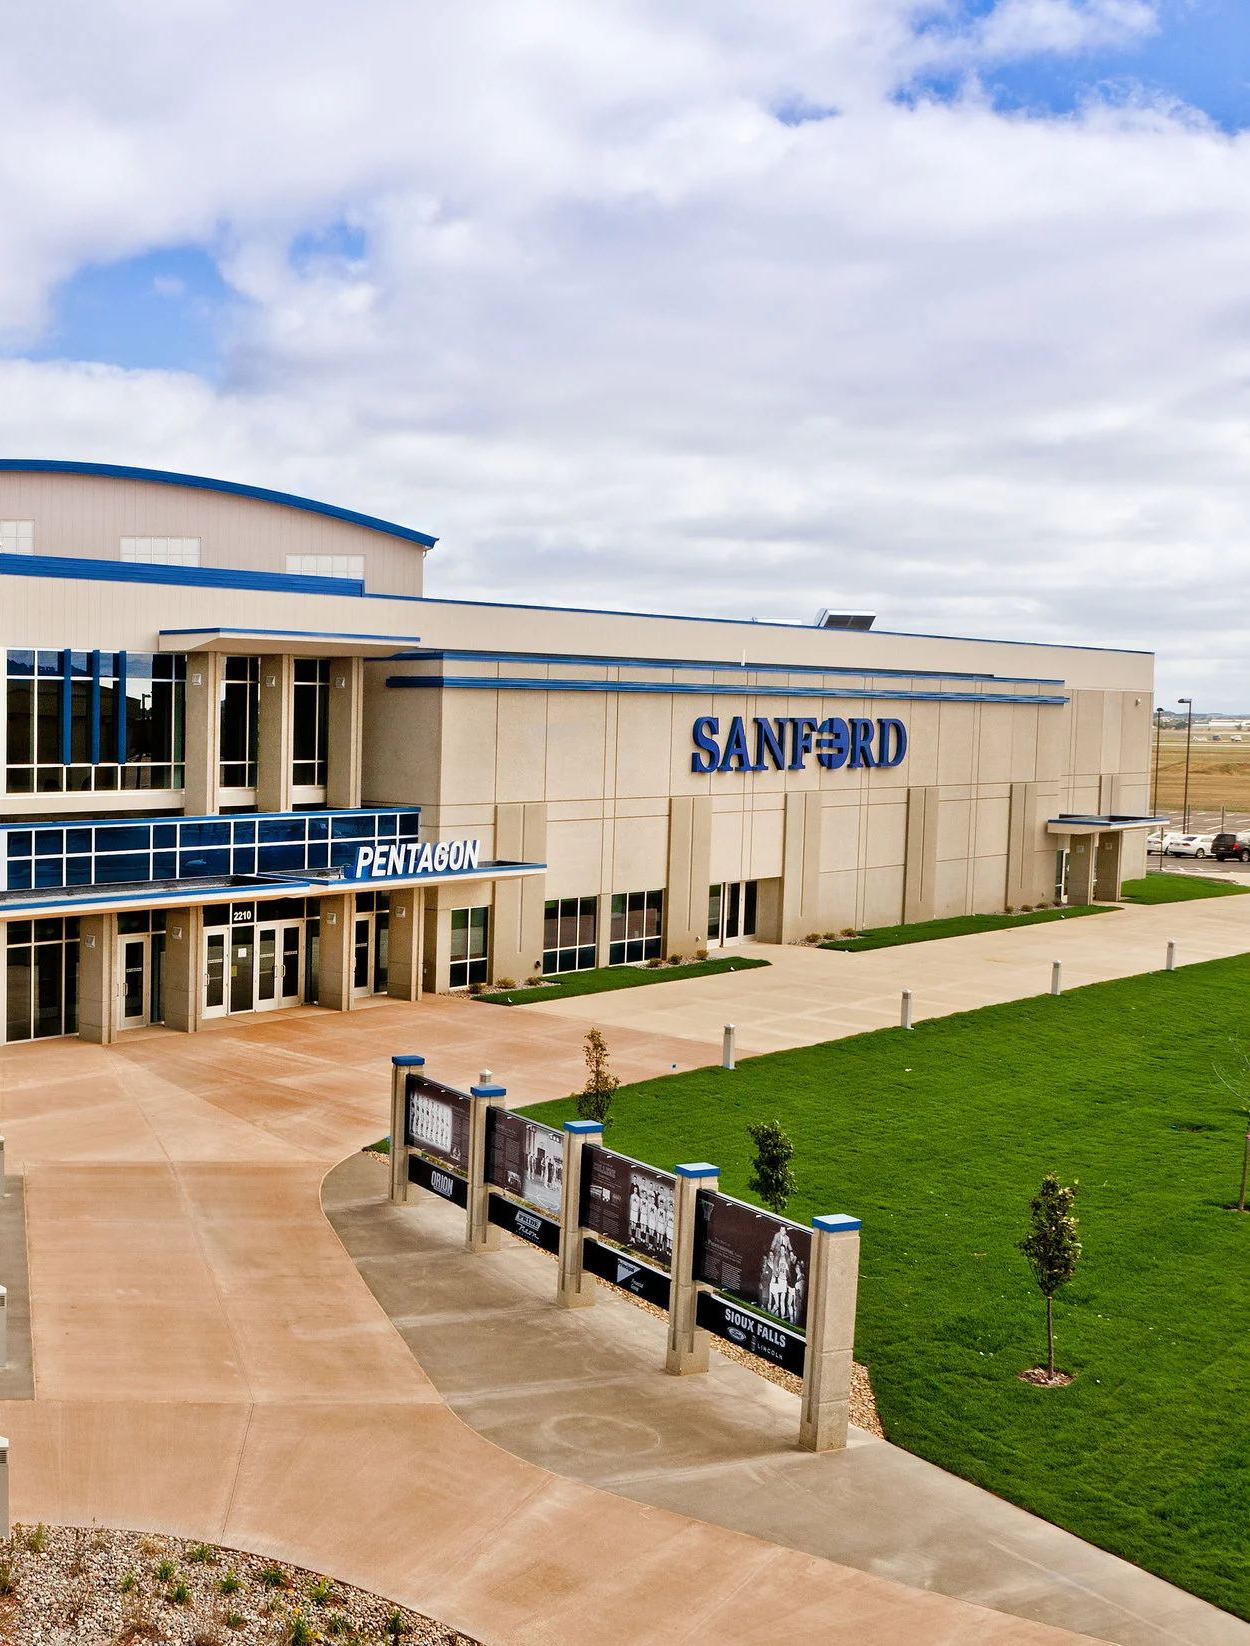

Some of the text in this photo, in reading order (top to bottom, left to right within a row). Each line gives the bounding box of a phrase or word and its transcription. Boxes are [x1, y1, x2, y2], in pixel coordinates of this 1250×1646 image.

[691, 716, 908, 773] SANFORD
[354, 839, 481, 879] PENTAGON
[233, 910, 252, 921] 2210
[431, 1170, 454, 1195] ORION
[725, 1308, 755, 1333] SIOUX
[757, 1323, 787, 1348] FALLS
[757, 1343, 783, 1360] LINCOLN
